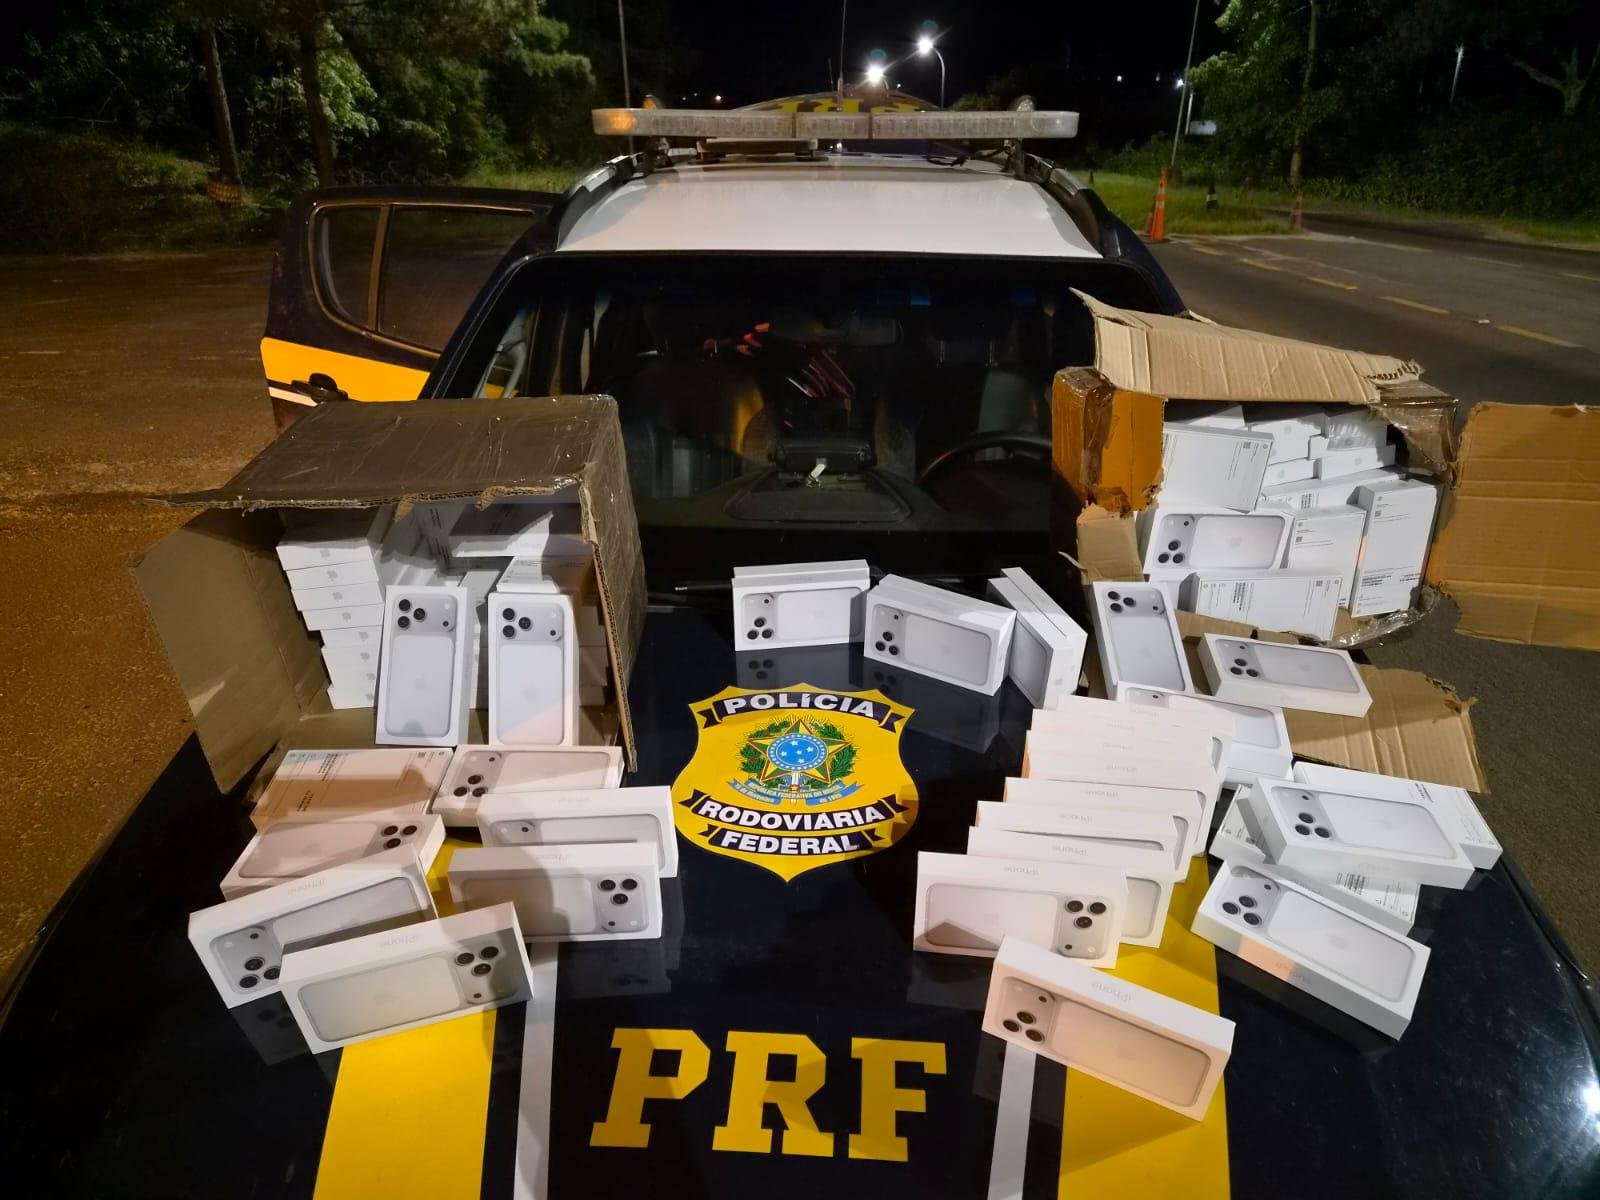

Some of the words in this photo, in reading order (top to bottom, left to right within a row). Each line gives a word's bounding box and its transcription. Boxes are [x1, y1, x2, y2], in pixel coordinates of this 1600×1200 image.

[724, 693, 875, 717] POLÍCIA
[699, 800, 885, 830] RODOVIÁRIA
[722, 831, 860, 854] FEDERAL
[589, 1027, 947, 1162] PRF
